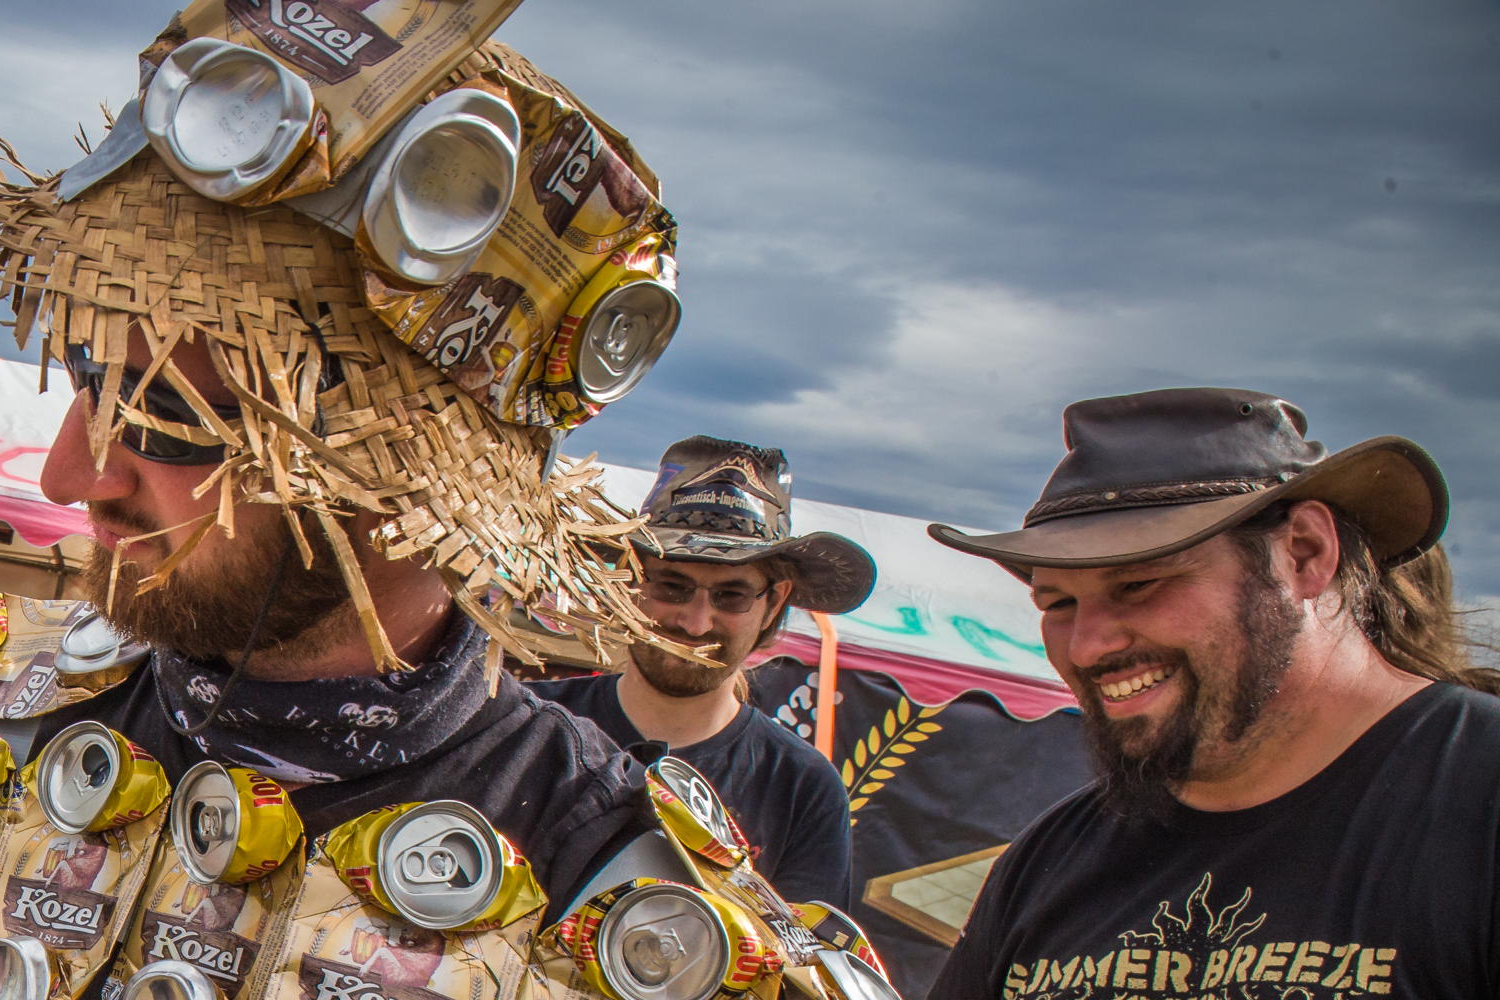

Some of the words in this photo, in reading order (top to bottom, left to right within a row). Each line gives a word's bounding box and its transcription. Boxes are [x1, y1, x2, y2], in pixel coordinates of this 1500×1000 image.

[253, 0, 374, 60] ozel
[263, 28, 299, 56] 1874
[0, 664, 55, 717] ozel
[11, 886, 104, 929] Kozel
[38, 931, 64, 945] 1874
[150, 920, 244, 975] Kozel
[1003, 949, 1192, 998] SUMMER
[1201, 940, 1397, 995] BREEZE
